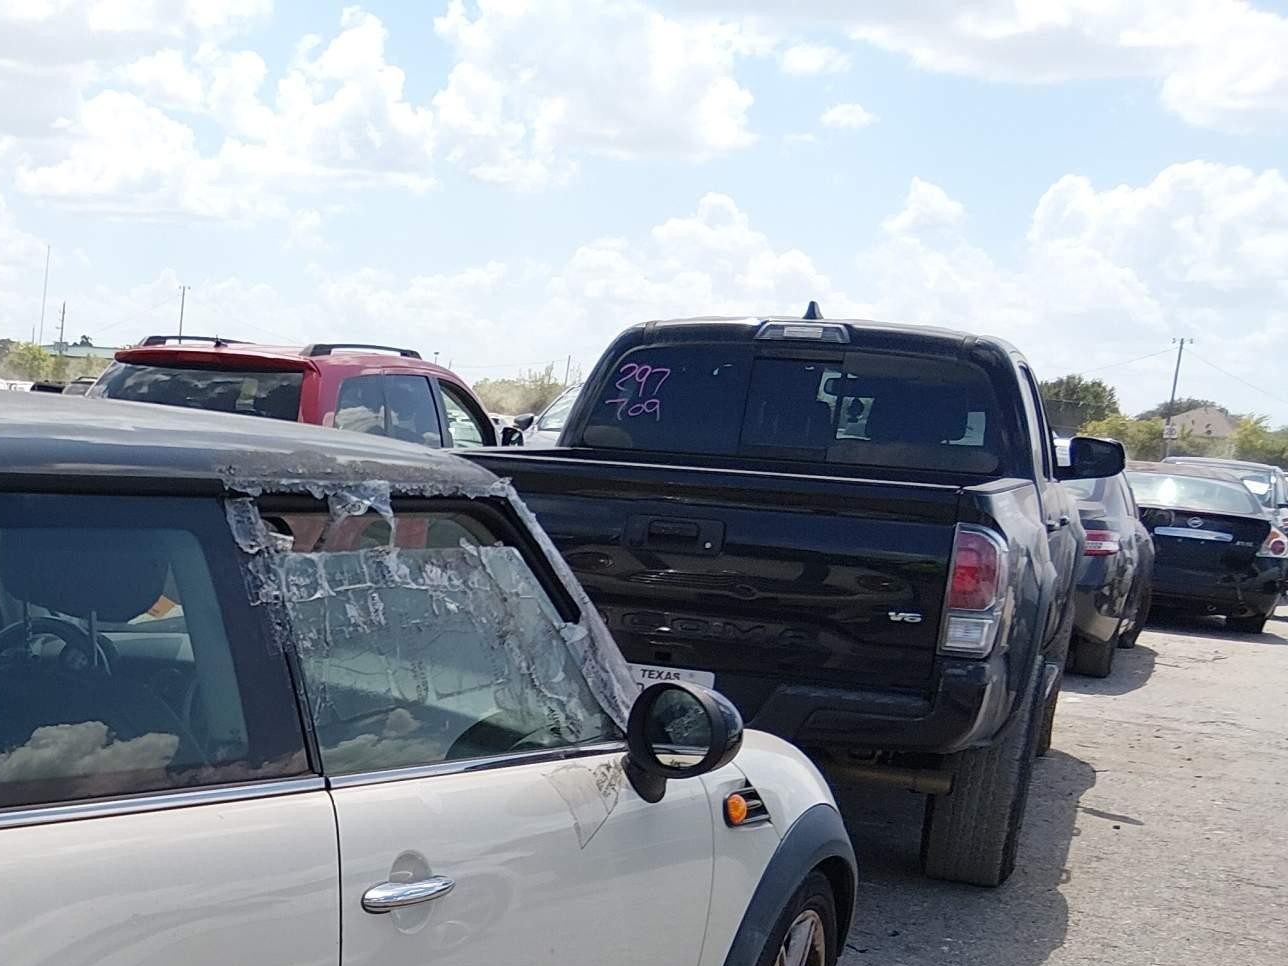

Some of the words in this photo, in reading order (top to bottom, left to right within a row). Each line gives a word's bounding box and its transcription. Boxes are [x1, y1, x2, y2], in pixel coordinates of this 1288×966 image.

[615, 363, 671, 398] 297
[605, 398, 660, 421] 709
[887, 611, 922, 623] V6
[640, 668, 681, 681] TEXAS
